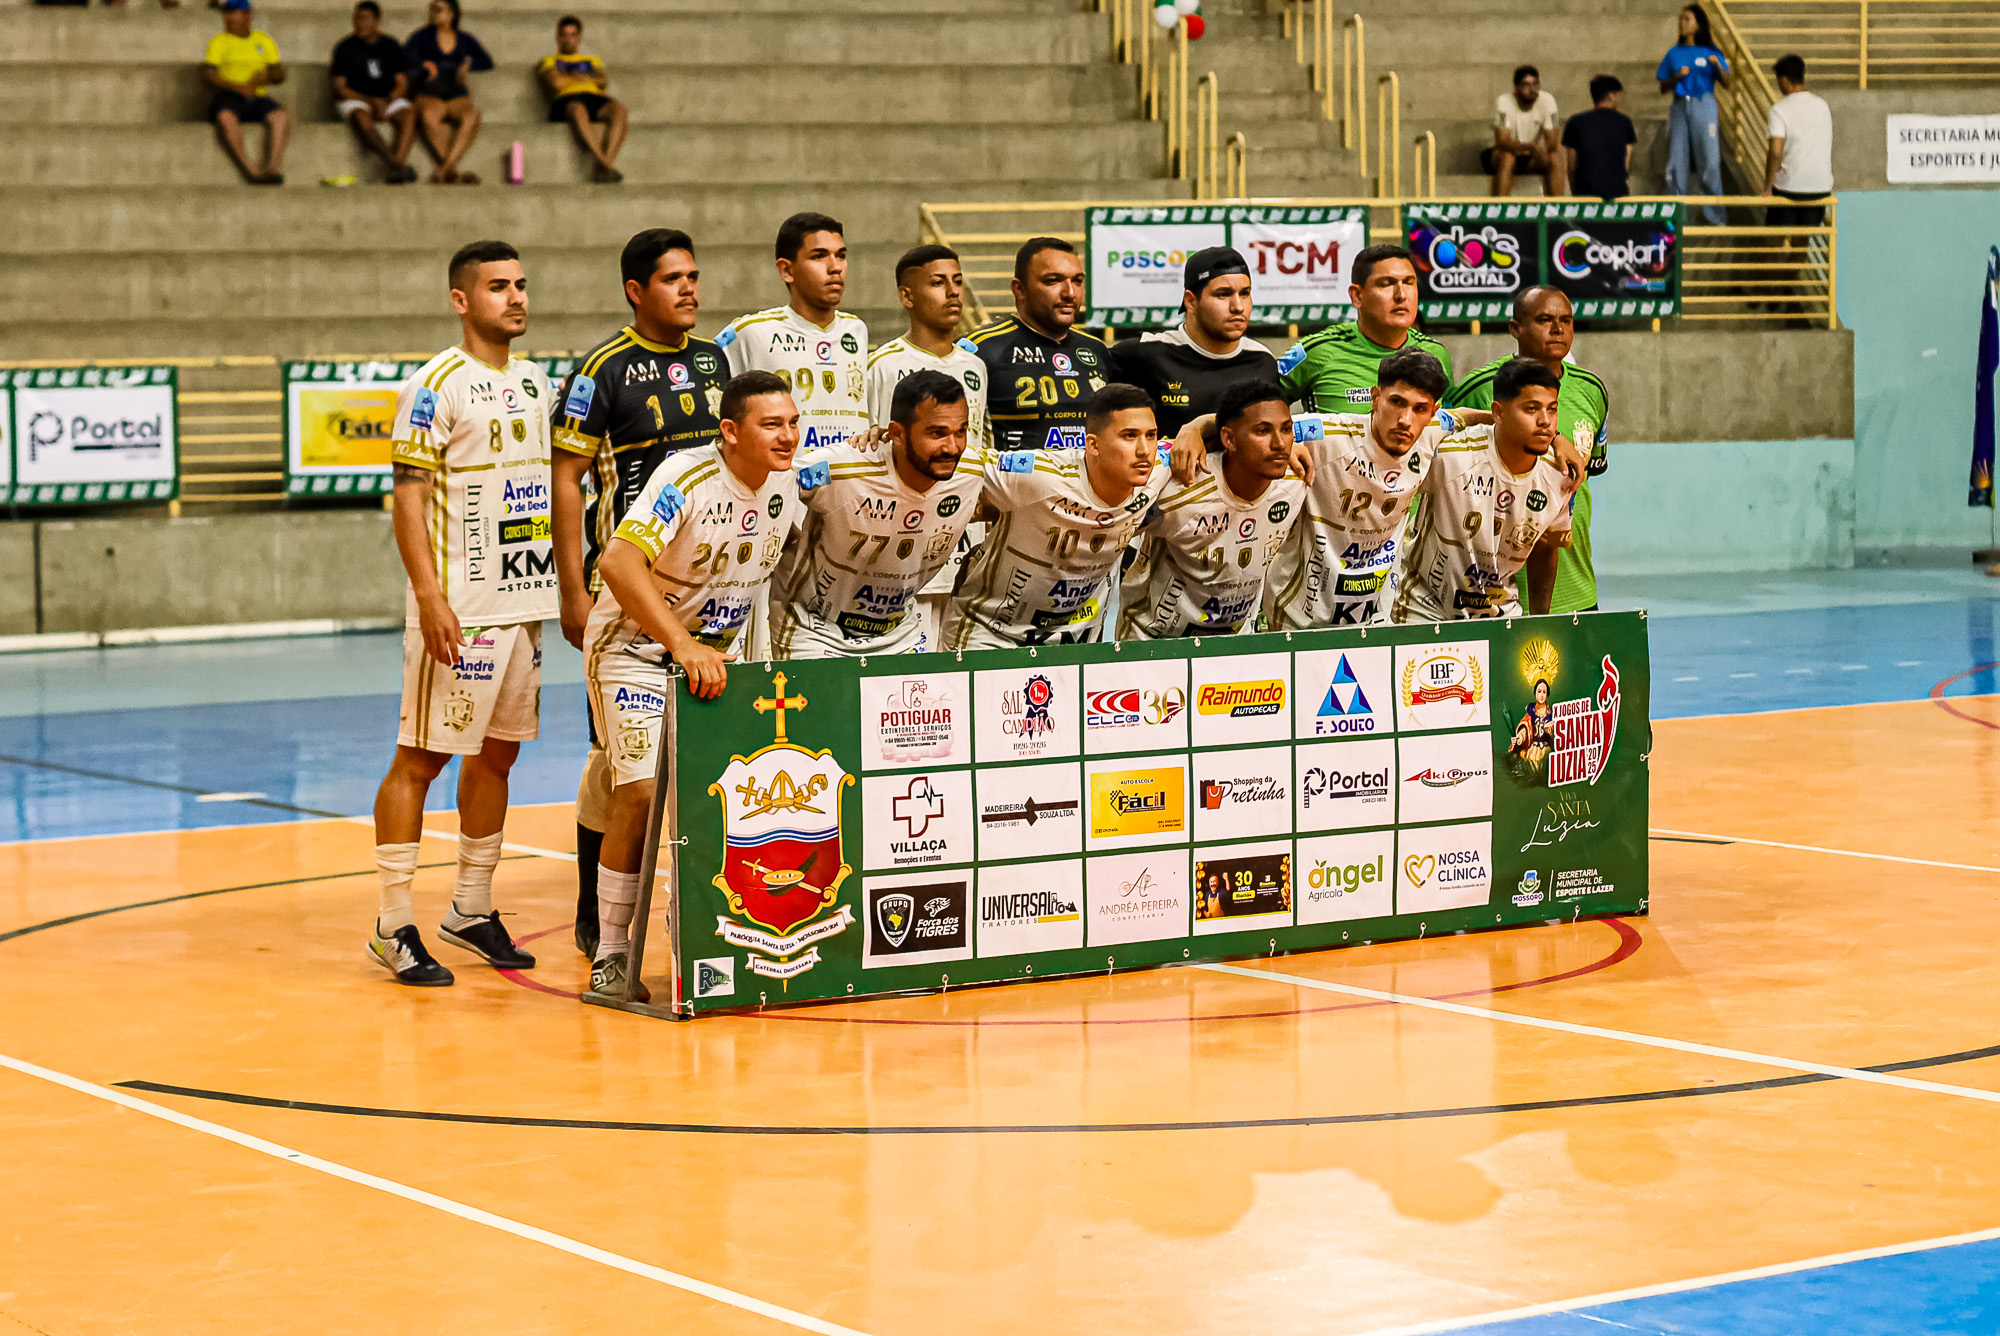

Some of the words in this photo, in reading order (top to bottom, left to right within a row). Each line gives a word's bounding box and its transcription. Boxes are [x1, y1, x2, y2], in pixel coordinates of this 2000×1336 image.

[1900, 127, 1980, 144] SECRETARIA
[1910, 152, 1976, 168] ESPORTES
[1980, 153, 1986, 167] E
[1248, 241, 1339, 275] TCM
[1440, 272, 1507, 287] DIGITAL
[1015, 375, 1059, 408] 20
[645, 394, 665, 431] 1
[71, 414, 161, 440] Portal
[489, 418, 503, 453] 8
[671, 432, 694, 441] CORPO
[396, 442, 408, 455] 10
[514, 501, 526, 513] de
[1338, 488, 1373, 522] 12
[464, 485, 485, 582] Imperial
[628, 522, 642, 535] 10
[1462, 511, 1483, 540] 9
[847, 529, 891, 566] 77
[1046, 526, 1081, 560] 10
[687, 541, 730, 577] 26
[873, 571, 899, 580] CORPO
[709, 620, 725, 630] de
[1002, 690, 1022, 715] SAL
[1200, 683, 1283, 706] Raimundo
[1143, 686, 1186, 725] 30
[1234, 704, 1277, 715] AUTOPEÇAS
[1553, 705, 1558, 719] X
[1559, 702, 1580, 717] JOGOS
[1581, 700, 1590, 713] DE
[881, 709, 952, 728] POTIGUAR
[1087, 715, 1125, 726] CLC
[1316, 721, 1326, 735] F.
[1330, 717, 1375, 733] SOUTO
[881, 726, 916, 735] EXTINTORES
[923, 724, 952, 732] SERVIÇOS
[1555, 713, 1601, 752] SANTA
[1588, 747, 1596, 759] 20
[1550, 749, 1587, 785] LUZIA
[1588, 761, 1596, 774] 25
[1233, 776, 1263, 787] Shopping
[1264, 775, 1273, 783] da
[1330, 767, 1388, 790] Portal
[1219, 780, 1286, 804] Pretinha
[985, 803, 1025, 813] MADEIREIRA
[1118, 791, 1165, 811] Fácil
[1039, 810, 1059, 819] SOUZA
[1060, 809, 1075, 817] LTDA.
[1547, 800, 1591, 825] SANTA
[1520, 808, 1601, 852] Luzia
[890, 839, 948, 853] VILLAÇA
[894, 856, 919, 865] Remoções
[923, 854, 942, 862] Eventos
[1438, 850, 1480, 866] NOSSA
[1235, 870, 1253, 886] 30
[1438, 866, 1487, 882] CLÍNICA
[1556, 877, 1593, 888] MUNICIPAL
[1593, 876, 1603, 884] DE
[1557, 868, 1598, 880] SECRETARIA
[1555, 886, 1586, 897] ESPORTE
[1592, 884, 1615, 893] LAZER
[883, 900, 908, 911] GRUPO
[982, 891, 1054, 921] UNIVERSAL
[1099, 899, 1140, 915] ANDRÉA
[1141, 898, 1179, 912] PEREIRA
[917, 918, 942, 928] Força
[942, 916, 960, 925] dos
[982, 918, 1038, 928] TRATORES
[1112, 912, 1165, 923] CONFEITARIA
[915, 924, 959, 938] TIGRES
[762, 938, 779, 950] SANTA
[755, 963, 782, 974] CATEDRAL
[783, 960, 812, 974] DIOCESANA
